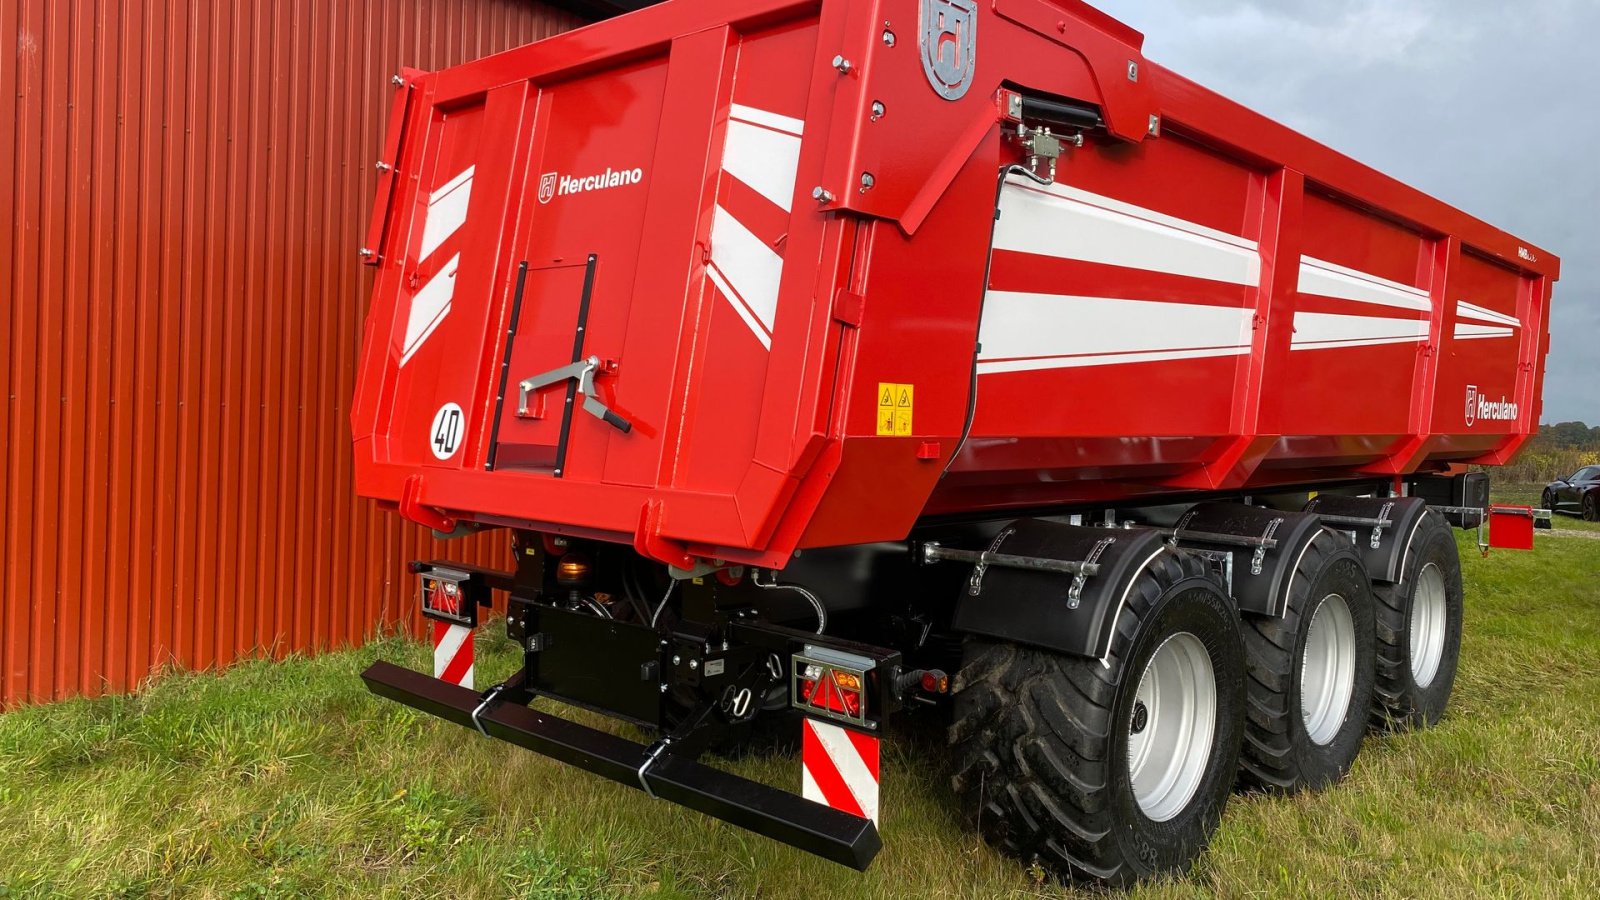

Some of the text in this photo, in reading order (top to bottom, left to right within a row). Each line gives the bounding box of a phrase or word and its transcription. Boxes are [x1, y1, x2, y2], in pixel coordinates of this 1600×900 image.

[558, 167, 643, 196] Herculano
[1477, 394, 1518, 420] Herculano
[434, 409, 460, 453] 40
